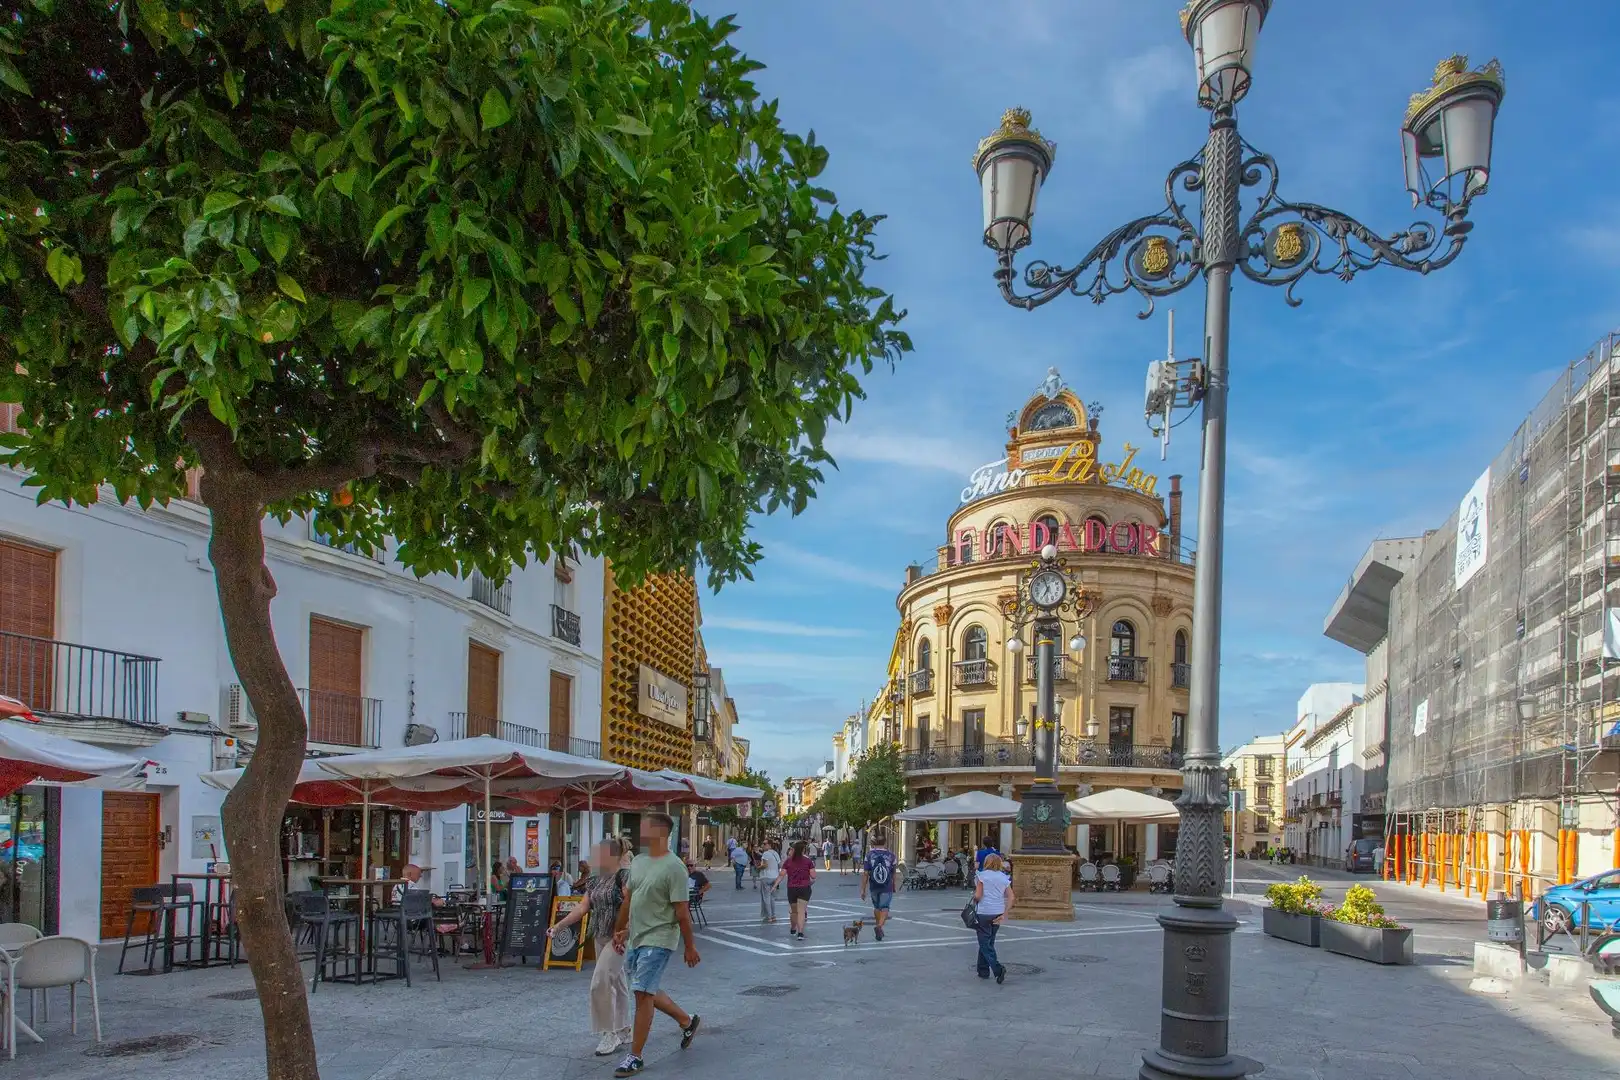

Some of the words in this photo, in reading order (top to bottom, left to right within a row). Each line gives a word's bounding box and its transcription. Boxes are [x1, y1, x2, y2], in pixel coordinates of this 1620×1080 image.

[961, 456, 1027, 503] Fino
[1031, 439, 1095, 483] La
[954, 519, 1160, 564] FUNDADOR
